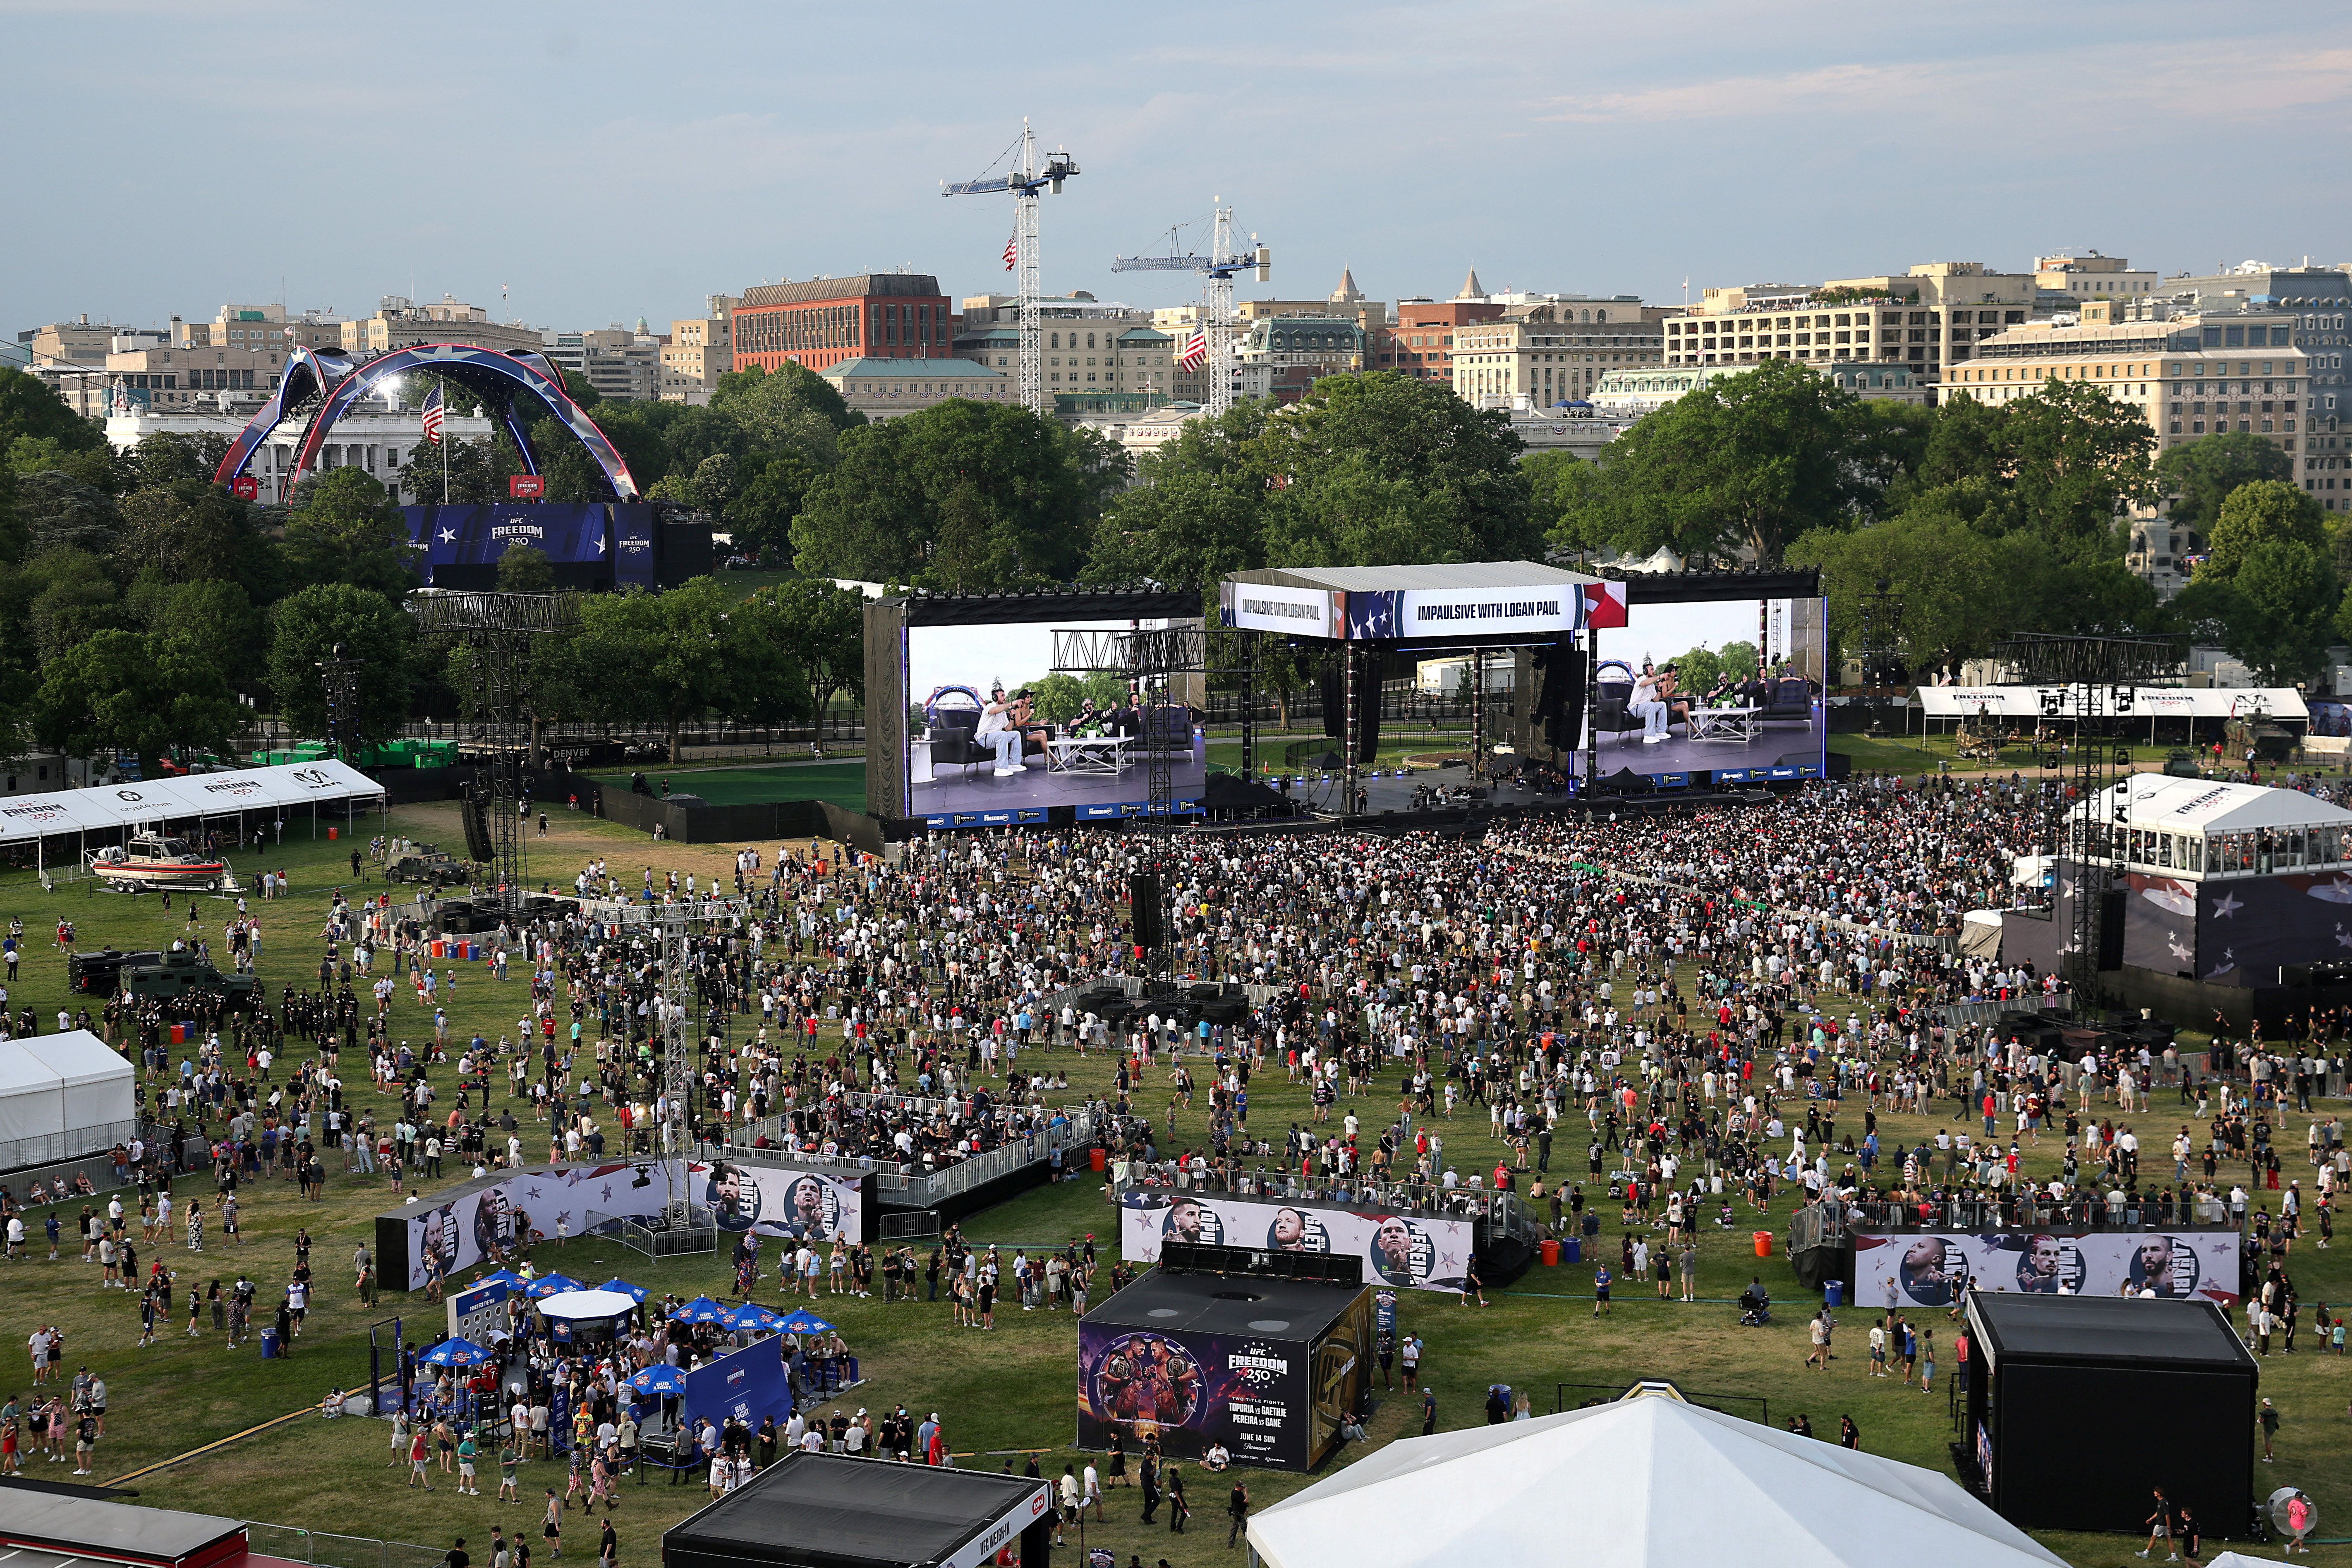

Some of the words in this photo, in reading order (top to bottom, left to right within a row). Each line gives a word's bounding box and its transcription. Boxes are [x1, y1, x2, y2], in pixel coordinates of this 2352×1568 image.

[492, 525, 543, 540] FREEDOM
[508, 537, 529, 548] 250
[1243, 598, 1273, 615] IMPAULSIVE
[1274, 602, 1287, 617] WITH
[1288, 603, 1305, 619] LOGAN
[1306, 605, 1320, 620] PAUL
[1418, 604, 1476, 620] IMPAULSIVE
[1478, 603, 1502, 618] WITH
[1504, 602, 1534, 617] LOGAN
[1537, 601, 1560, 615] PAUL
[204, 781, 263, 792] FREEDOM
[120, 802, 172, 812] crypto.com
[2176, 787, 2232, 814] FREEDOM
[2201, 796, 2224, 808] 250
[1, 804, 68, 817] FREEDOM
[30, 812, 55, 820] 250
[739, 1176, 754, 1219] RUFFY
[822, 1185, 833, 1235] CHANDLER
[443, 1214, 455, 1257] HOKIT
[2172, 1238, 2190, 1293] ZAHABI
[1229, 1354, 1287, 1375] FREEDOM
[492, 1371, 495, 1380] 7
[727, 1369, 745, 1384] FREEDOM
[1246, 1369, 1270, 1383] 250
[734, 1403, 746, 1413] BUD
[734, 1408, 749, 1421] LIGHT
[1229, 1402, 1254, 1414] TOPURIA
[1261, 1406, 1287, 1417] GAETHJE
[1233, 1414, 1258, 1425] PEREIRA
[1265, 1417, 1281, 1427] GANE
[1240, 1433, 1254, 1441] JUNE
[1243, 1442, 1271, 1451] Paramount+
[1033, 1495, 1043, 1510] total
[980, 1537, 989, 1556] UFC
[989, 1521, 1010, 1549] WEIGH-IN
